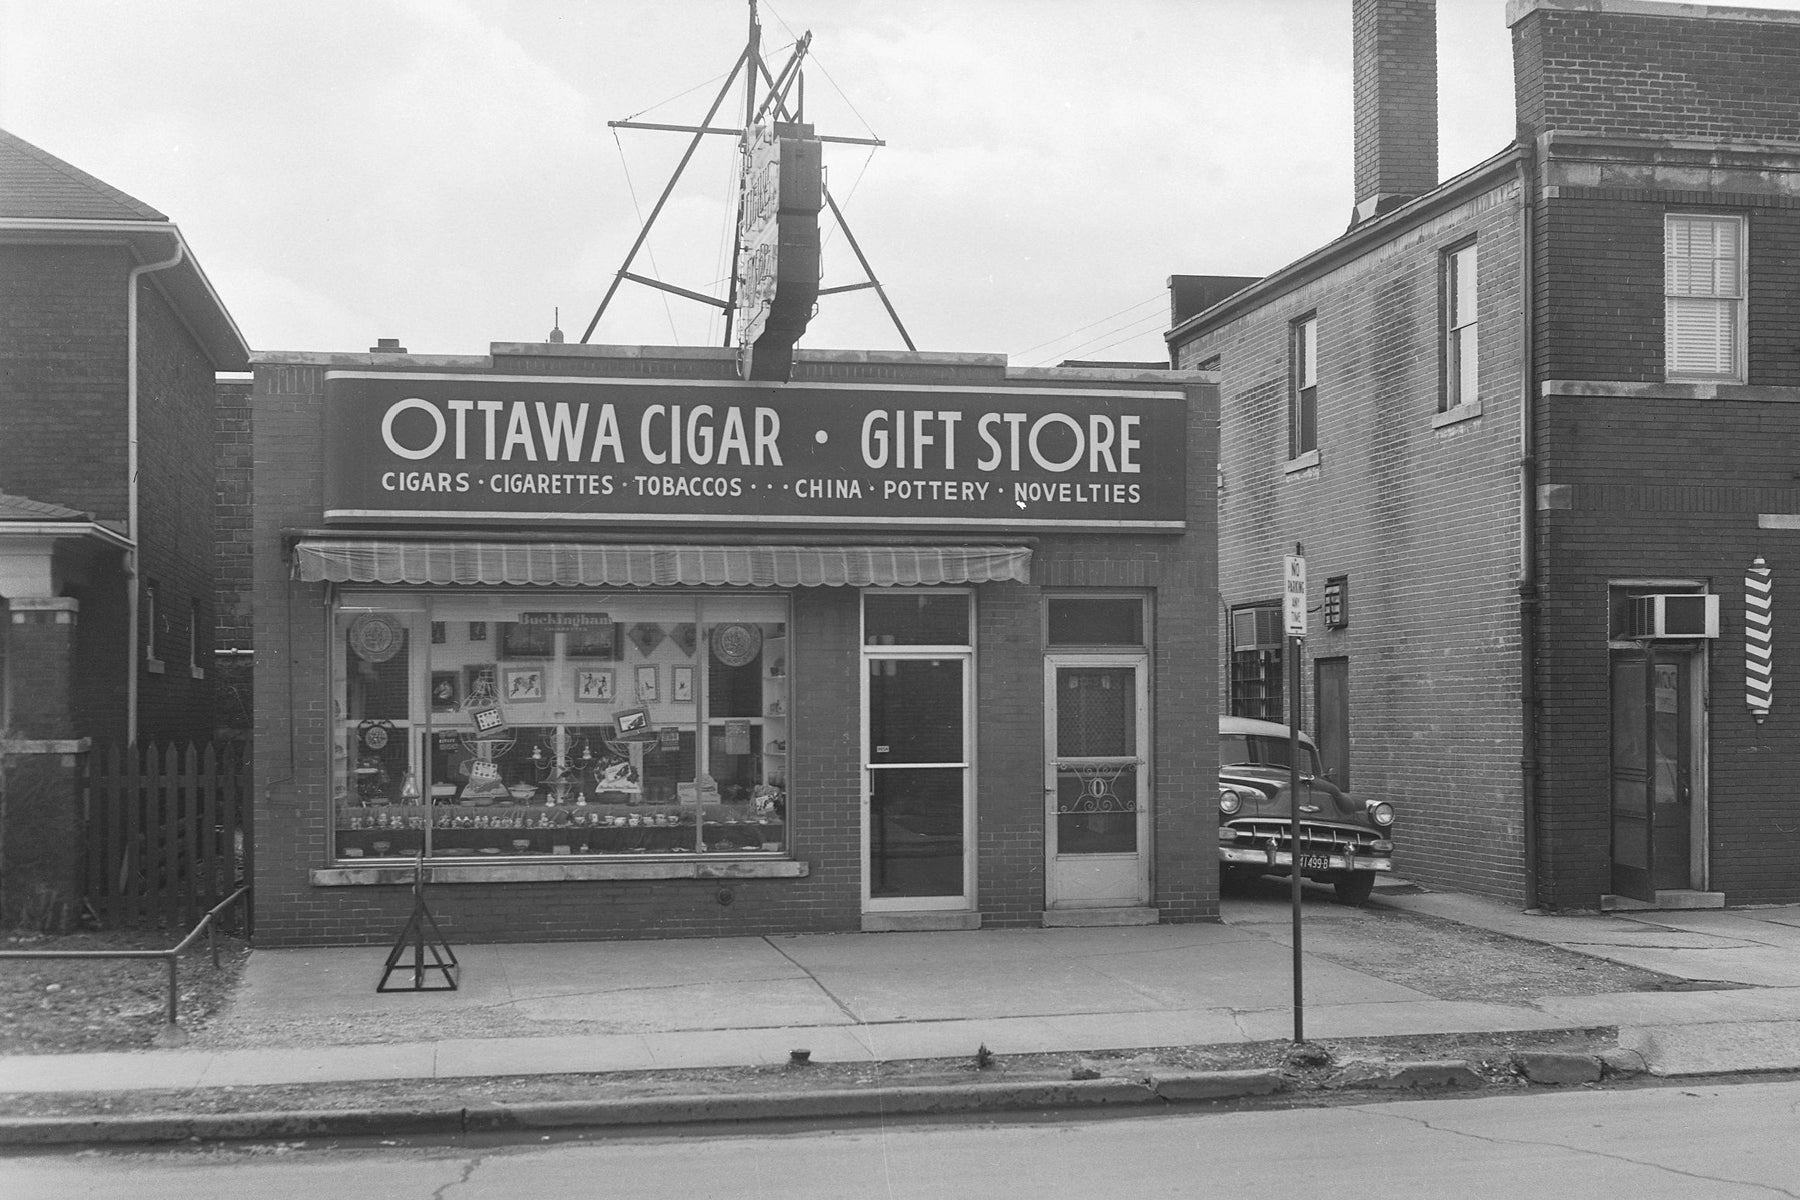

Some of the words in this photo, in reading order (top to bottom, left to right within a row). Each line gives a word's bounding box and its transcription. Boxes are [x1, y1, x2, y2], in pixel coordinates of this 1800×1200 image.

[381, 398, 625, 463] OTTAWA
[640, 403, 784, 467] CIGAR
[861, 409, 962, 470] GIFT
[977, 412, 1141, 473] STORE
[381, 471, 470, 492] CIGARS
[490, 473, 614, 495] CIGARETTES
[634, 475, 742, 497] TOBACCOS
[795, 478, 862, 499] CHINA
[884, 480, 990, 501] POTTERY
[1014, 482, 1141, 504] NOVELTIES
[1291, 562, 1300, 577] NO
[1287, 579, 1305, 594] PARKING
[519, 613, 612, 627] Buckingham
